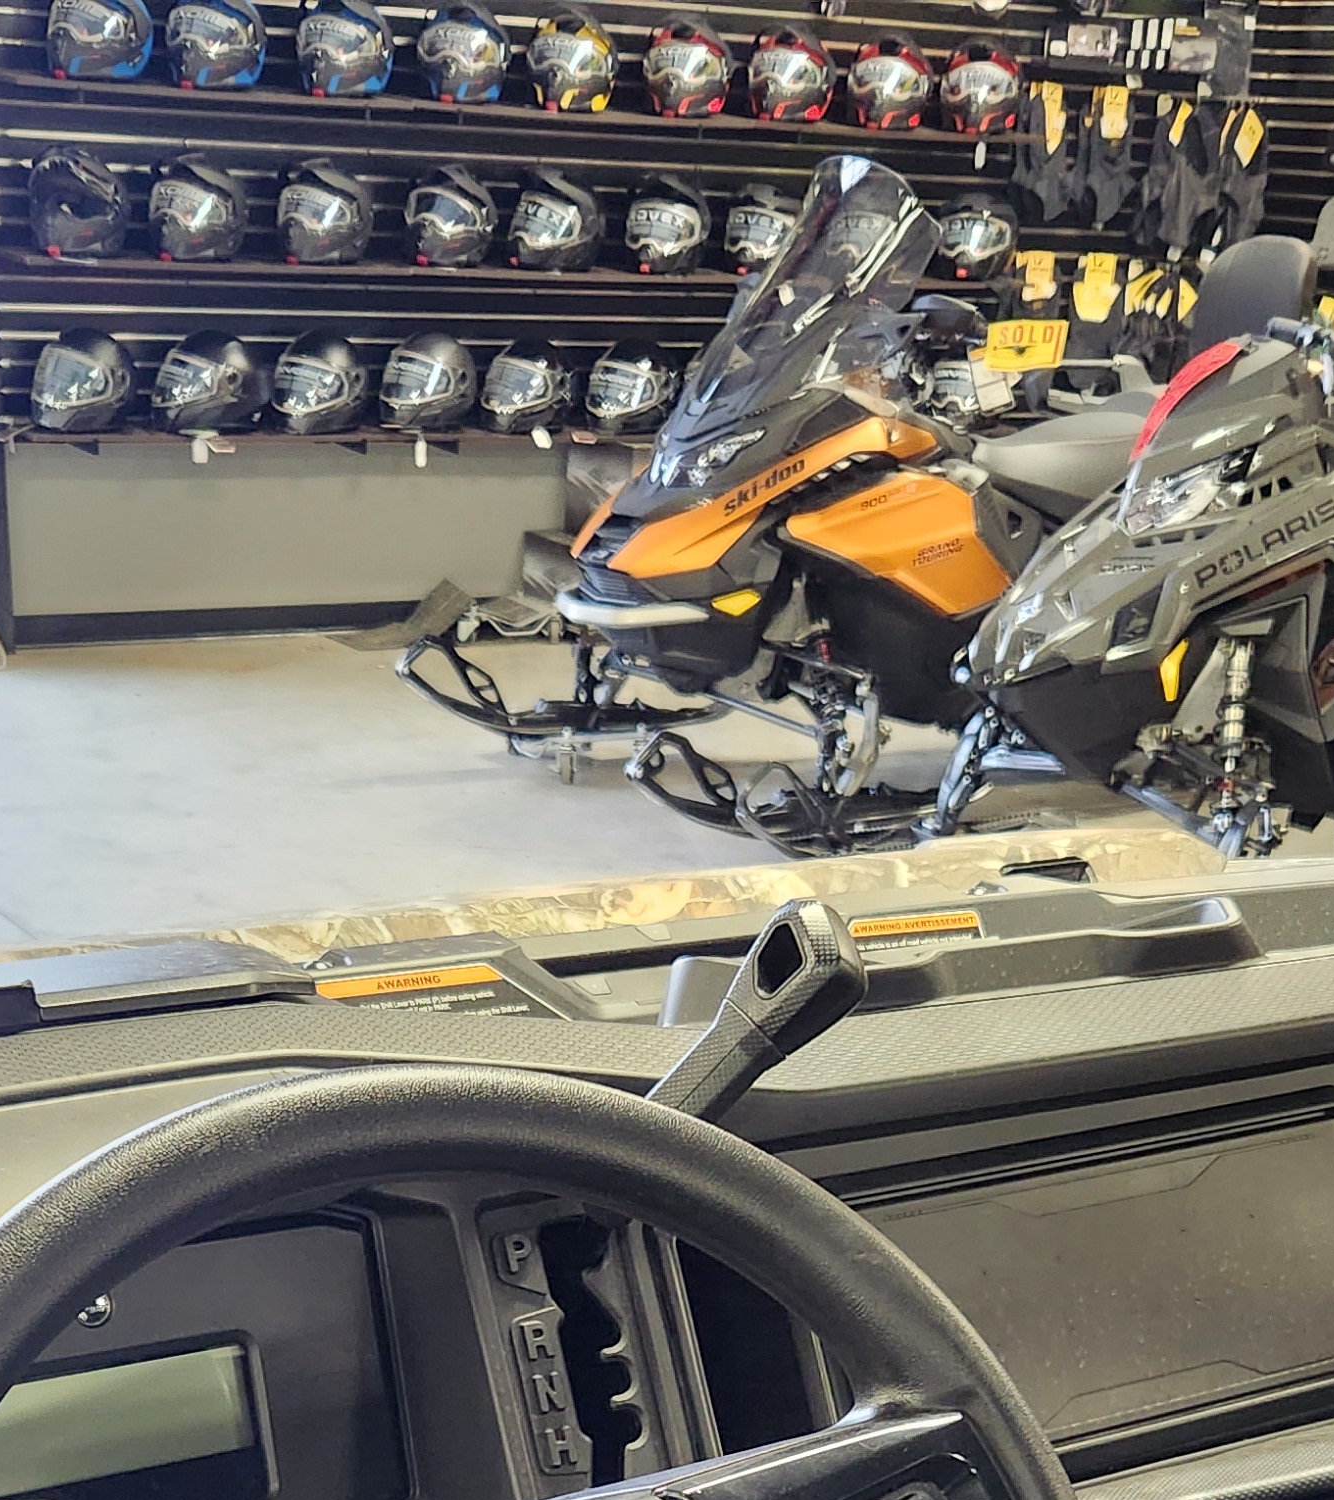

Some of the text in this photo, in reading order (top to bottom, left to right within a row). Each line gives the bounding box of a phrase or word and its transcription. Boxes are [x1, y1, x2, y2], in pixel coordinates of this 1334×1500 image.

[997, 324, 1056, 346] SOLD
[723, 459, 806, 517] ski-doo
[860, 916, 975, 933] WARNING AVERTISSEMENT
[384, 974, 442, 989] WARNING
[504, 1233, 532, 1274] P
[521, 1320, 556, 1362] R
[531, 1373, 566, 1414] N
[543, 1425, 578, 1468] H
